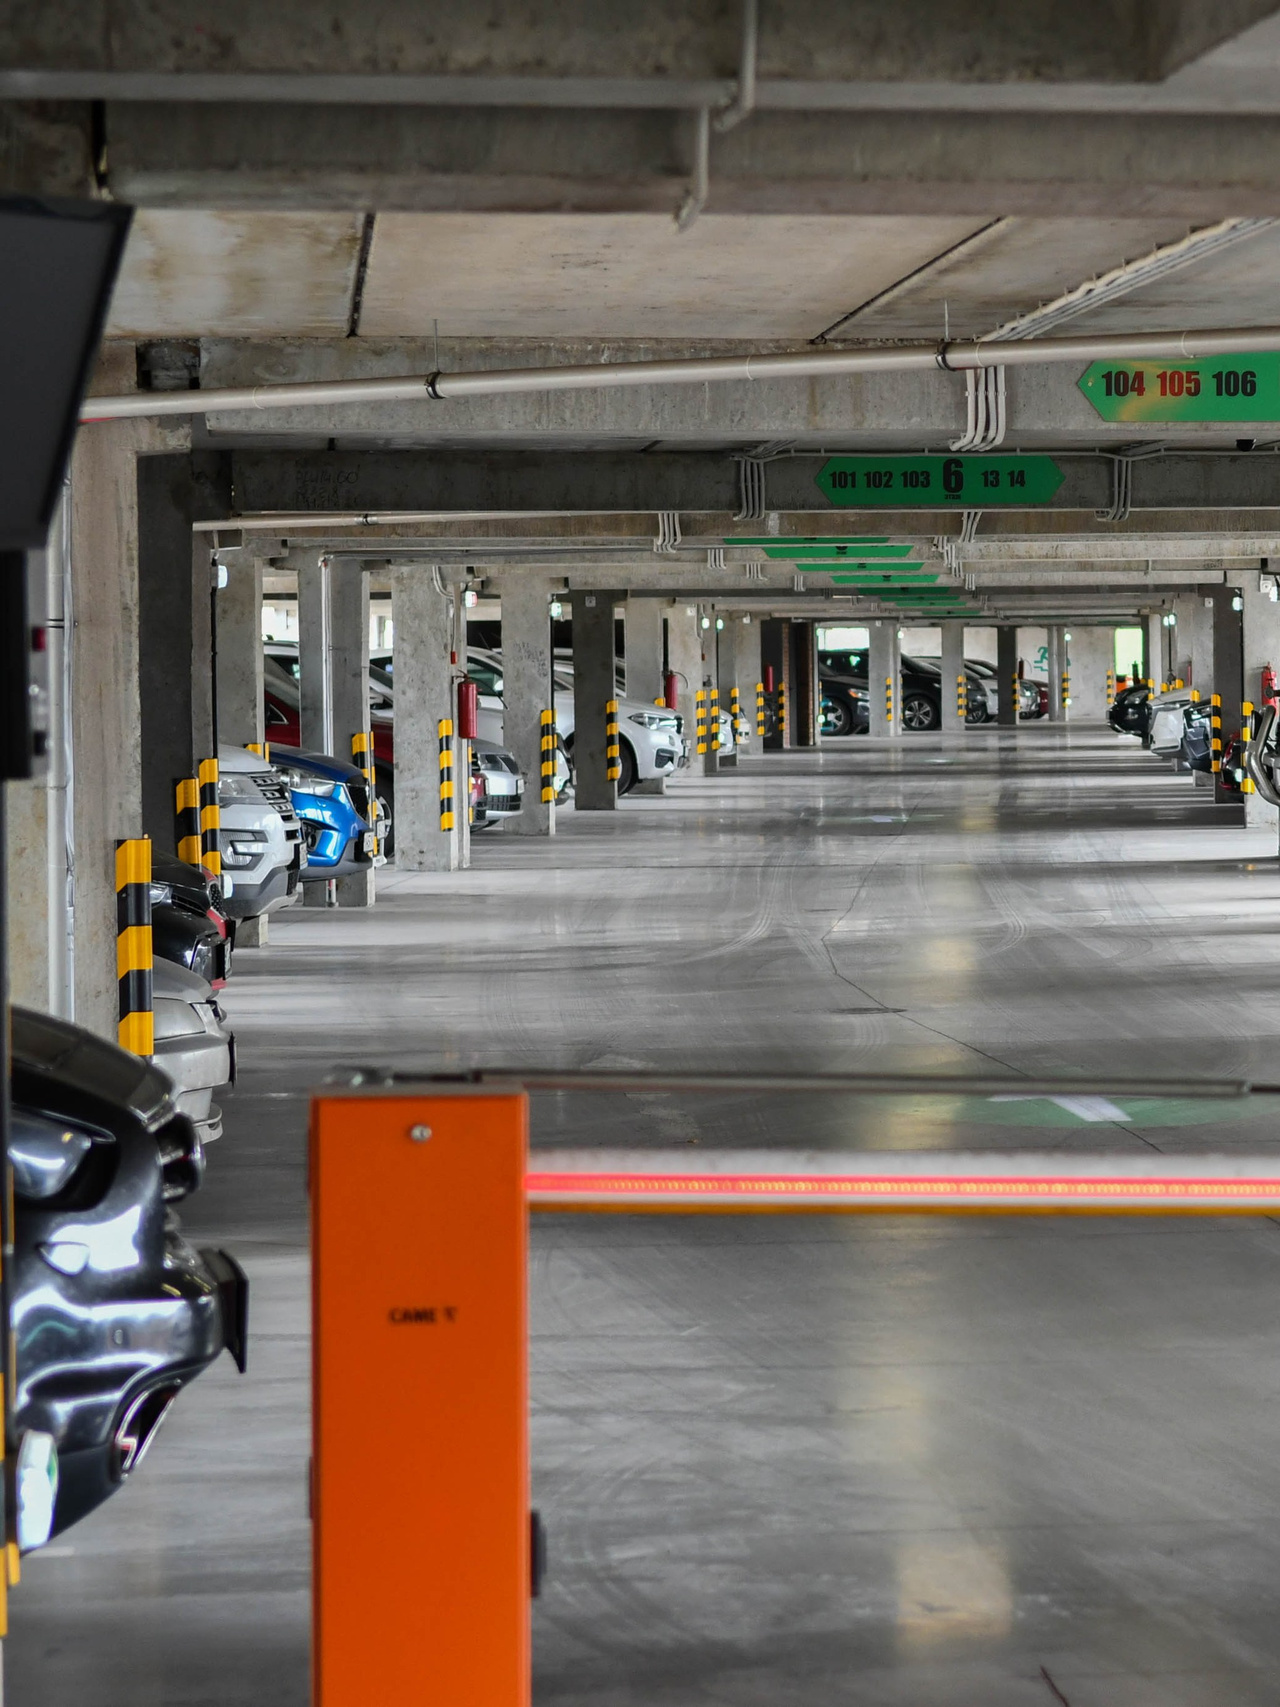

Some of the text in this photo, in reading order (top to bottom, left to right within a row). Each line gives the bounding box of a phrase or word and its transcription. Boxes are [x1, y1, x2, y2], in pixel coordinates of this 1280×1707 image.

[1102, 370, 1145, 397] 104
[1156, 370, 1201, 397] 105
[1212, 370, 1257, 397] 106
[829, 458, 1026, 494] 101 102 103 6 13 14
